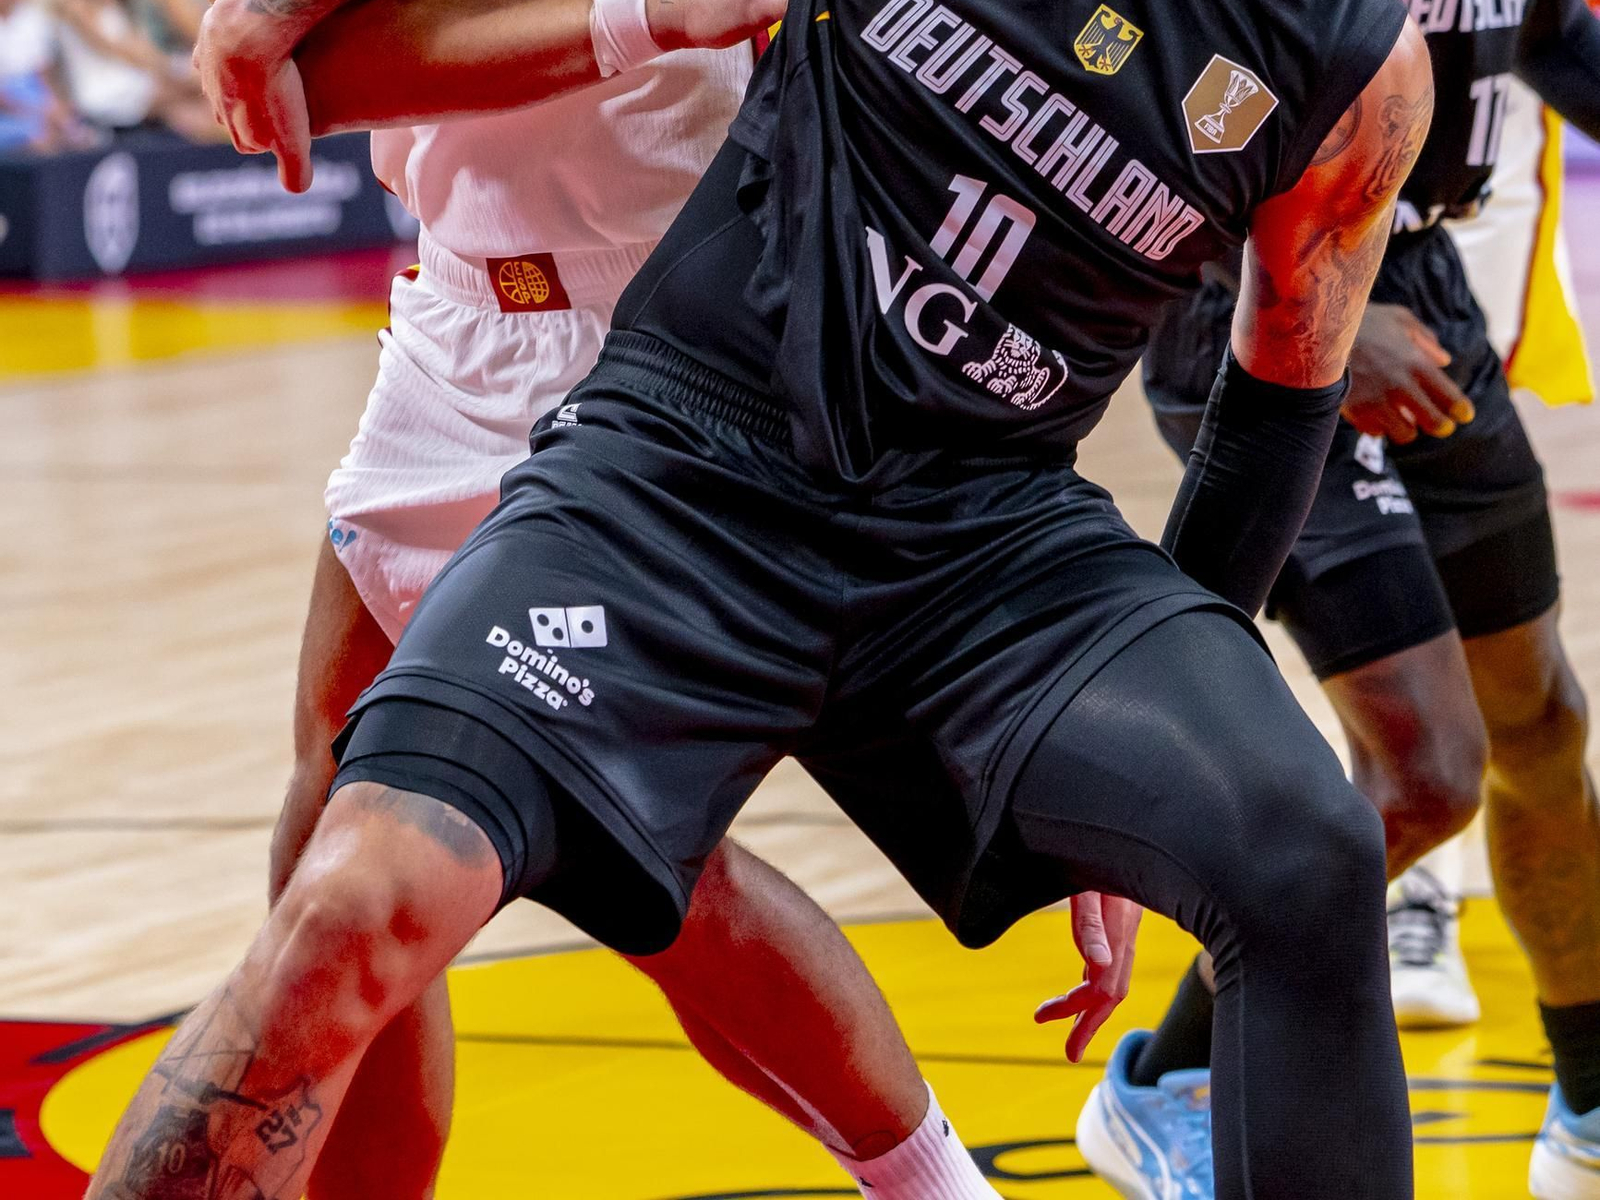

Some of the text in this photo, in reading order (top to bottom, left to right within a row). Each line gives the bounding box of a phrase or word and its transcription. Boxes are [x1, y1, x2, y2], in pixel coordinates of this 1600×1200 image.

[929, 173, 1037, 303] 10
[486, 625, 595, 706] Domino's
[498, 656, 564, 710] Pizza
